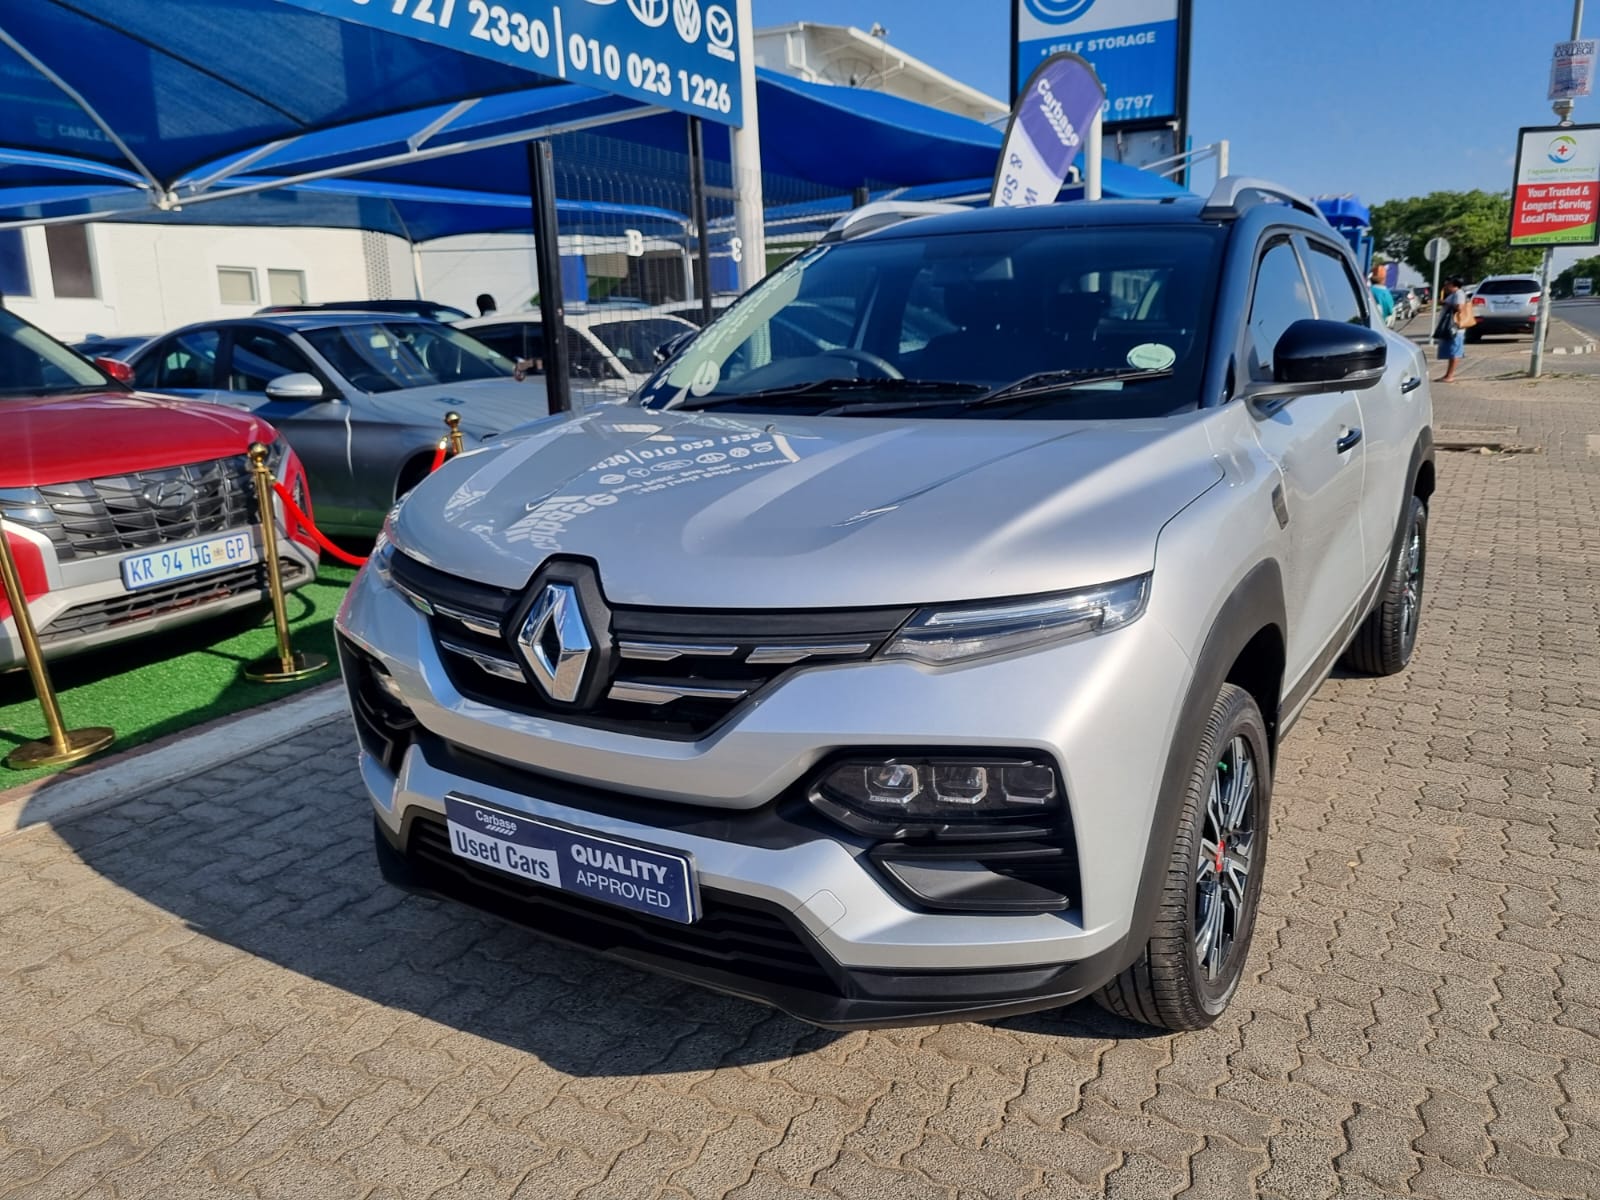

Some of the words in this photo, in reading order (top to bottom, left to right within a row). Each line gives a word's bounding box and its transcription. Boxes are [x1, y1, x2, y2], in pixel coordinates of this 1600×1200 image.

[1087, 31, 1156, 52] STORAGE
[467, 0, 549, 59] 2330
[568, 33, 620, 81] 010
[626, 52, 672, 97] 023
[677, 69, 731, 114] 1226
[1037, 78, 1079, 146] Carbase
[1114, 95, 1153, 111] 6797
[1522, 200, 1557, 212] Longest
[1559, 199, 1592, 210] Serving
[1528, 187, 1547, 198] Your
[1549, 186, 1581, 197] Trusted
[1582, 185, 1589, 195] &
[1521, 213, 1545, 223] Local
[1546, 212, 1590, 223] Pharmacy
[130, 558, 155, 582] KR
[162, 551, 183, 575] 94
[190, 545, 212, 568] HG
[225, 538, 245, 560] GP
[475, 810, 518, 831] Carbase
[455, 829, 500, 864] Used
[506, 848, 550, 880] Cars
[570, 843, 668, 885] QUALITY
[576, 869, 671, 908] APPROVED
